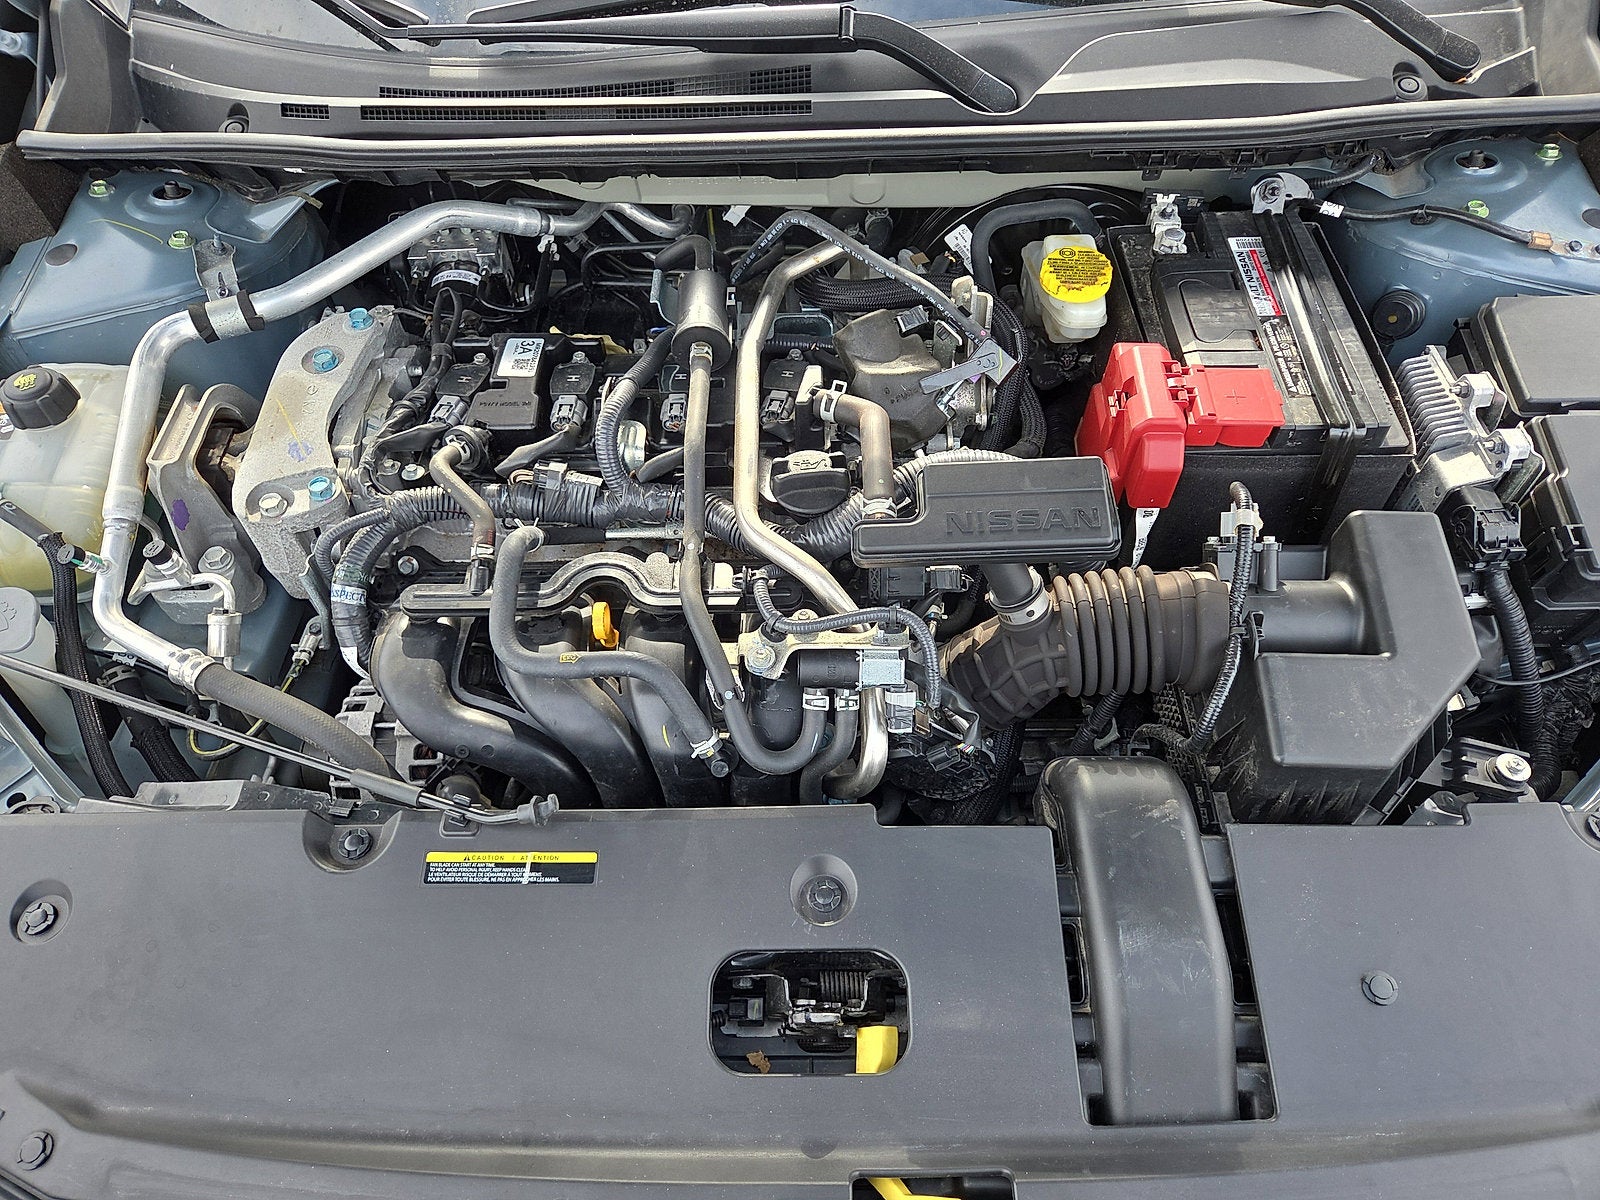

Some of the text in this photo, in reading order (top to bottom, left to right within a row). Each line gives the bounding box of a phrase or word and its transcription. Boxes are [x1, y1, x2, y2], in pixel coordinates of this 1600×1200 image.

[1236, 251, 1255, 283] NISSAN
[517, 340, 536, 355] 3A
[946, 507, 1102, 533] NISSAN
